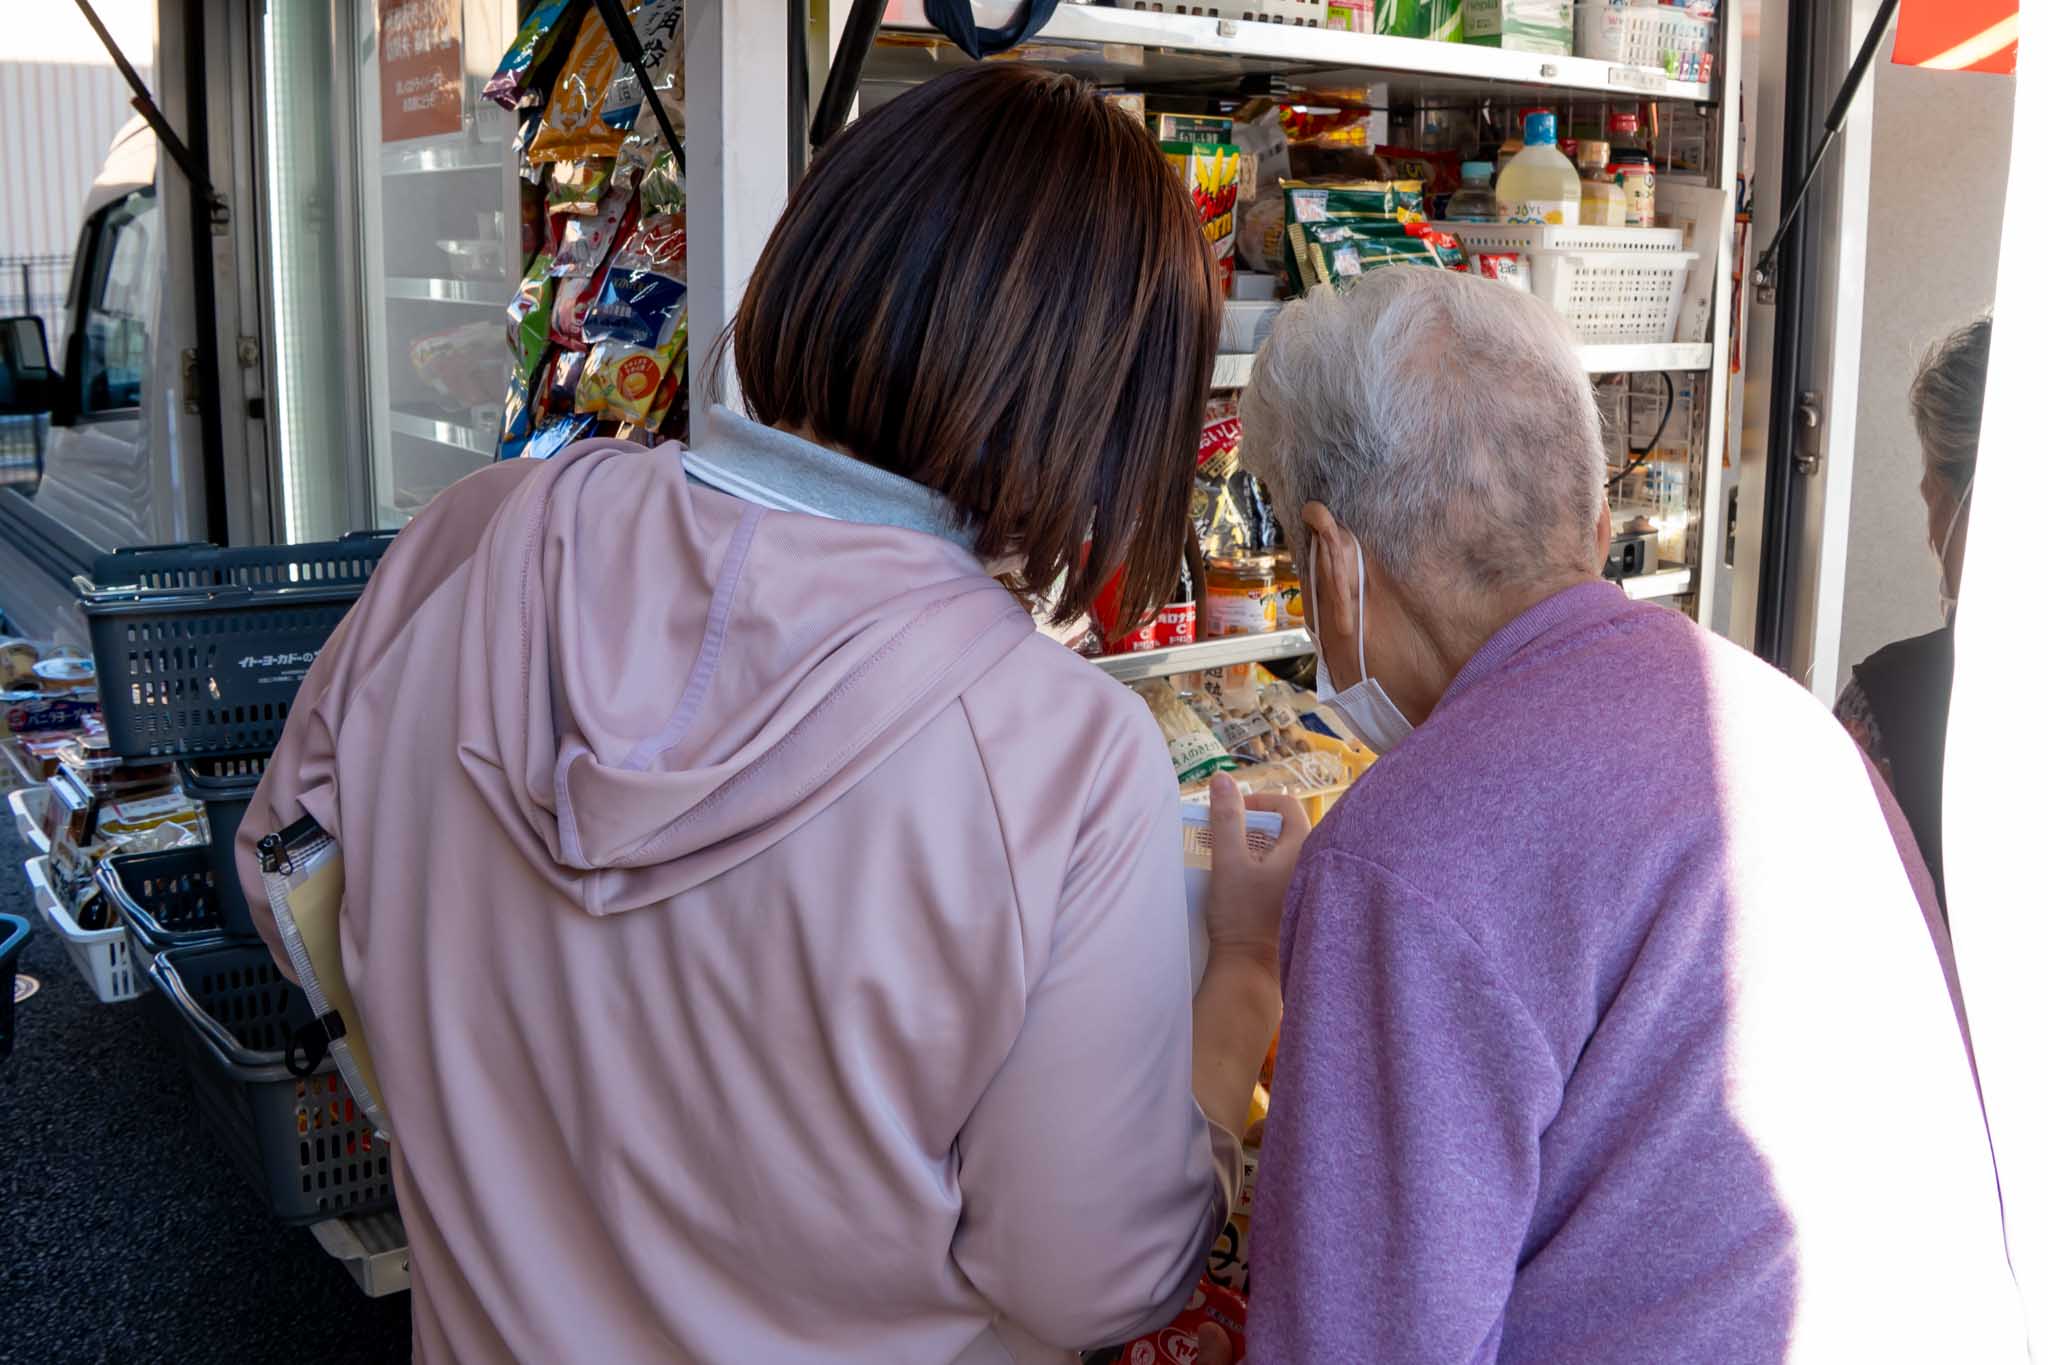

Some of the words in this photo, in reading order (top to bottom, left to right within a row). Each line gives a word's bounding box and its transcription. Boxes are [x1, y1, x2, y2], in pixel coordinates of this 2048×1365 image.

[238, 651, 320, 668] イトーヨーカドーの
